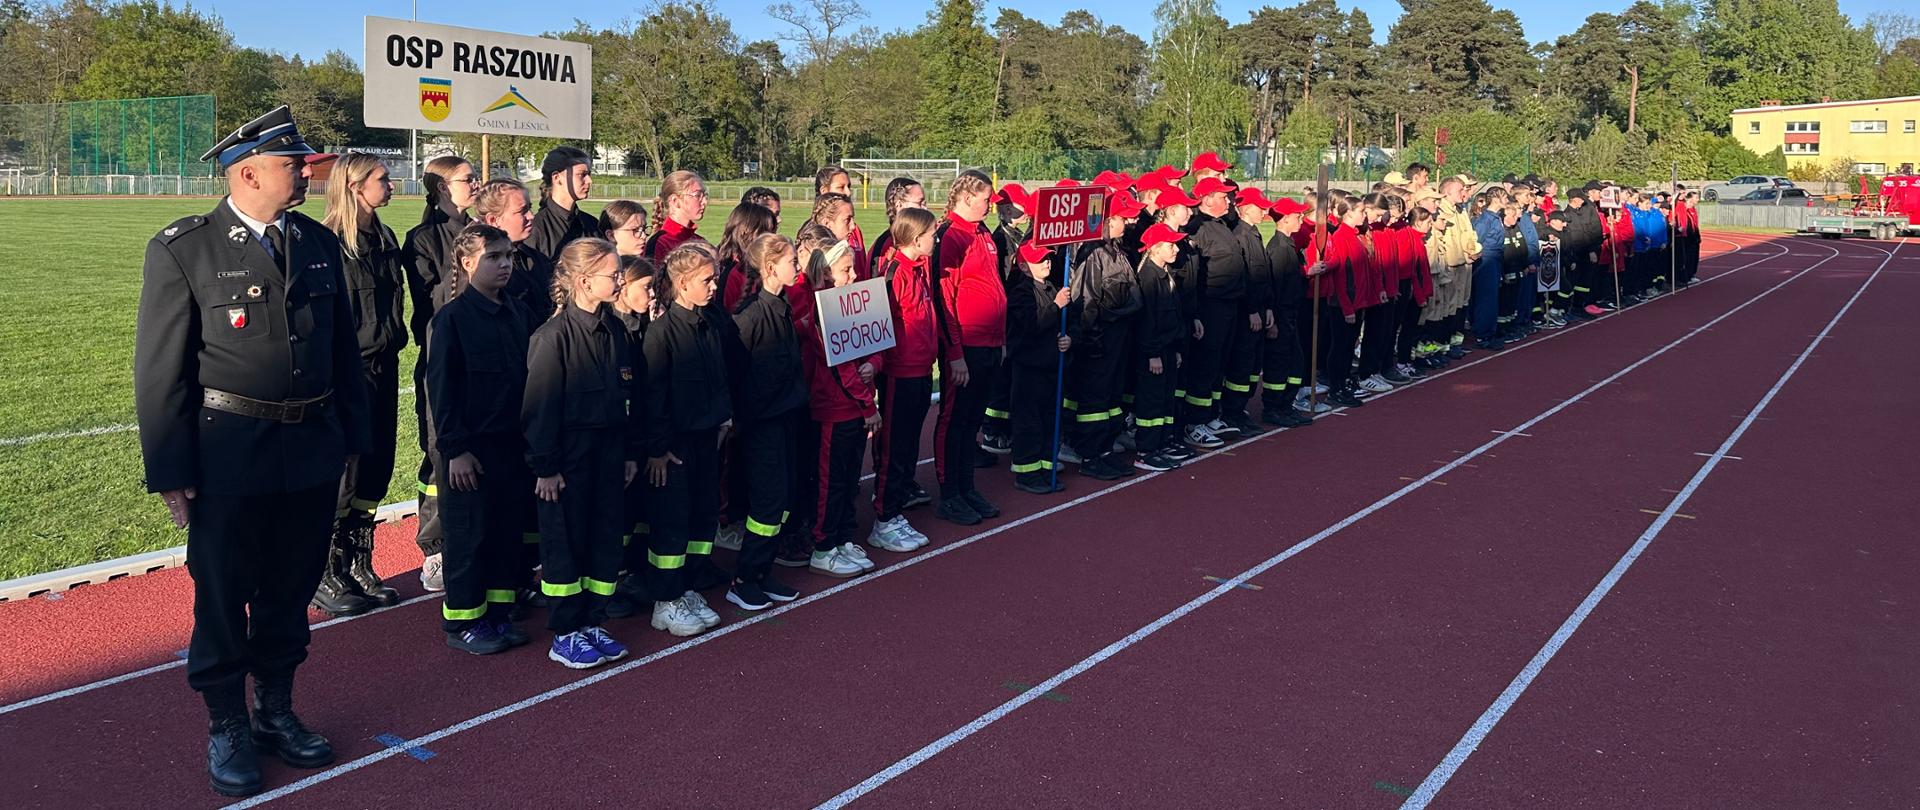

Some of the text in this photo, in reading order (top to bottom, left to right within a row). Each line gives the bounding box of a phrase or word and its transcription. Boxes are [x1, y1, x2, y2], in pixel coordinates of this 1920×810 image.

[386, 34, 576, 84] OSP RASZOWA
[477, 117, 510, 129] GMINA
[1049, 193, 1081, 218] OSP
[1039, 219, 1084, 240] KADŁUB
[839, 289, 871, 317] MDP
[830, 317, 892, 355] SPÓROK
